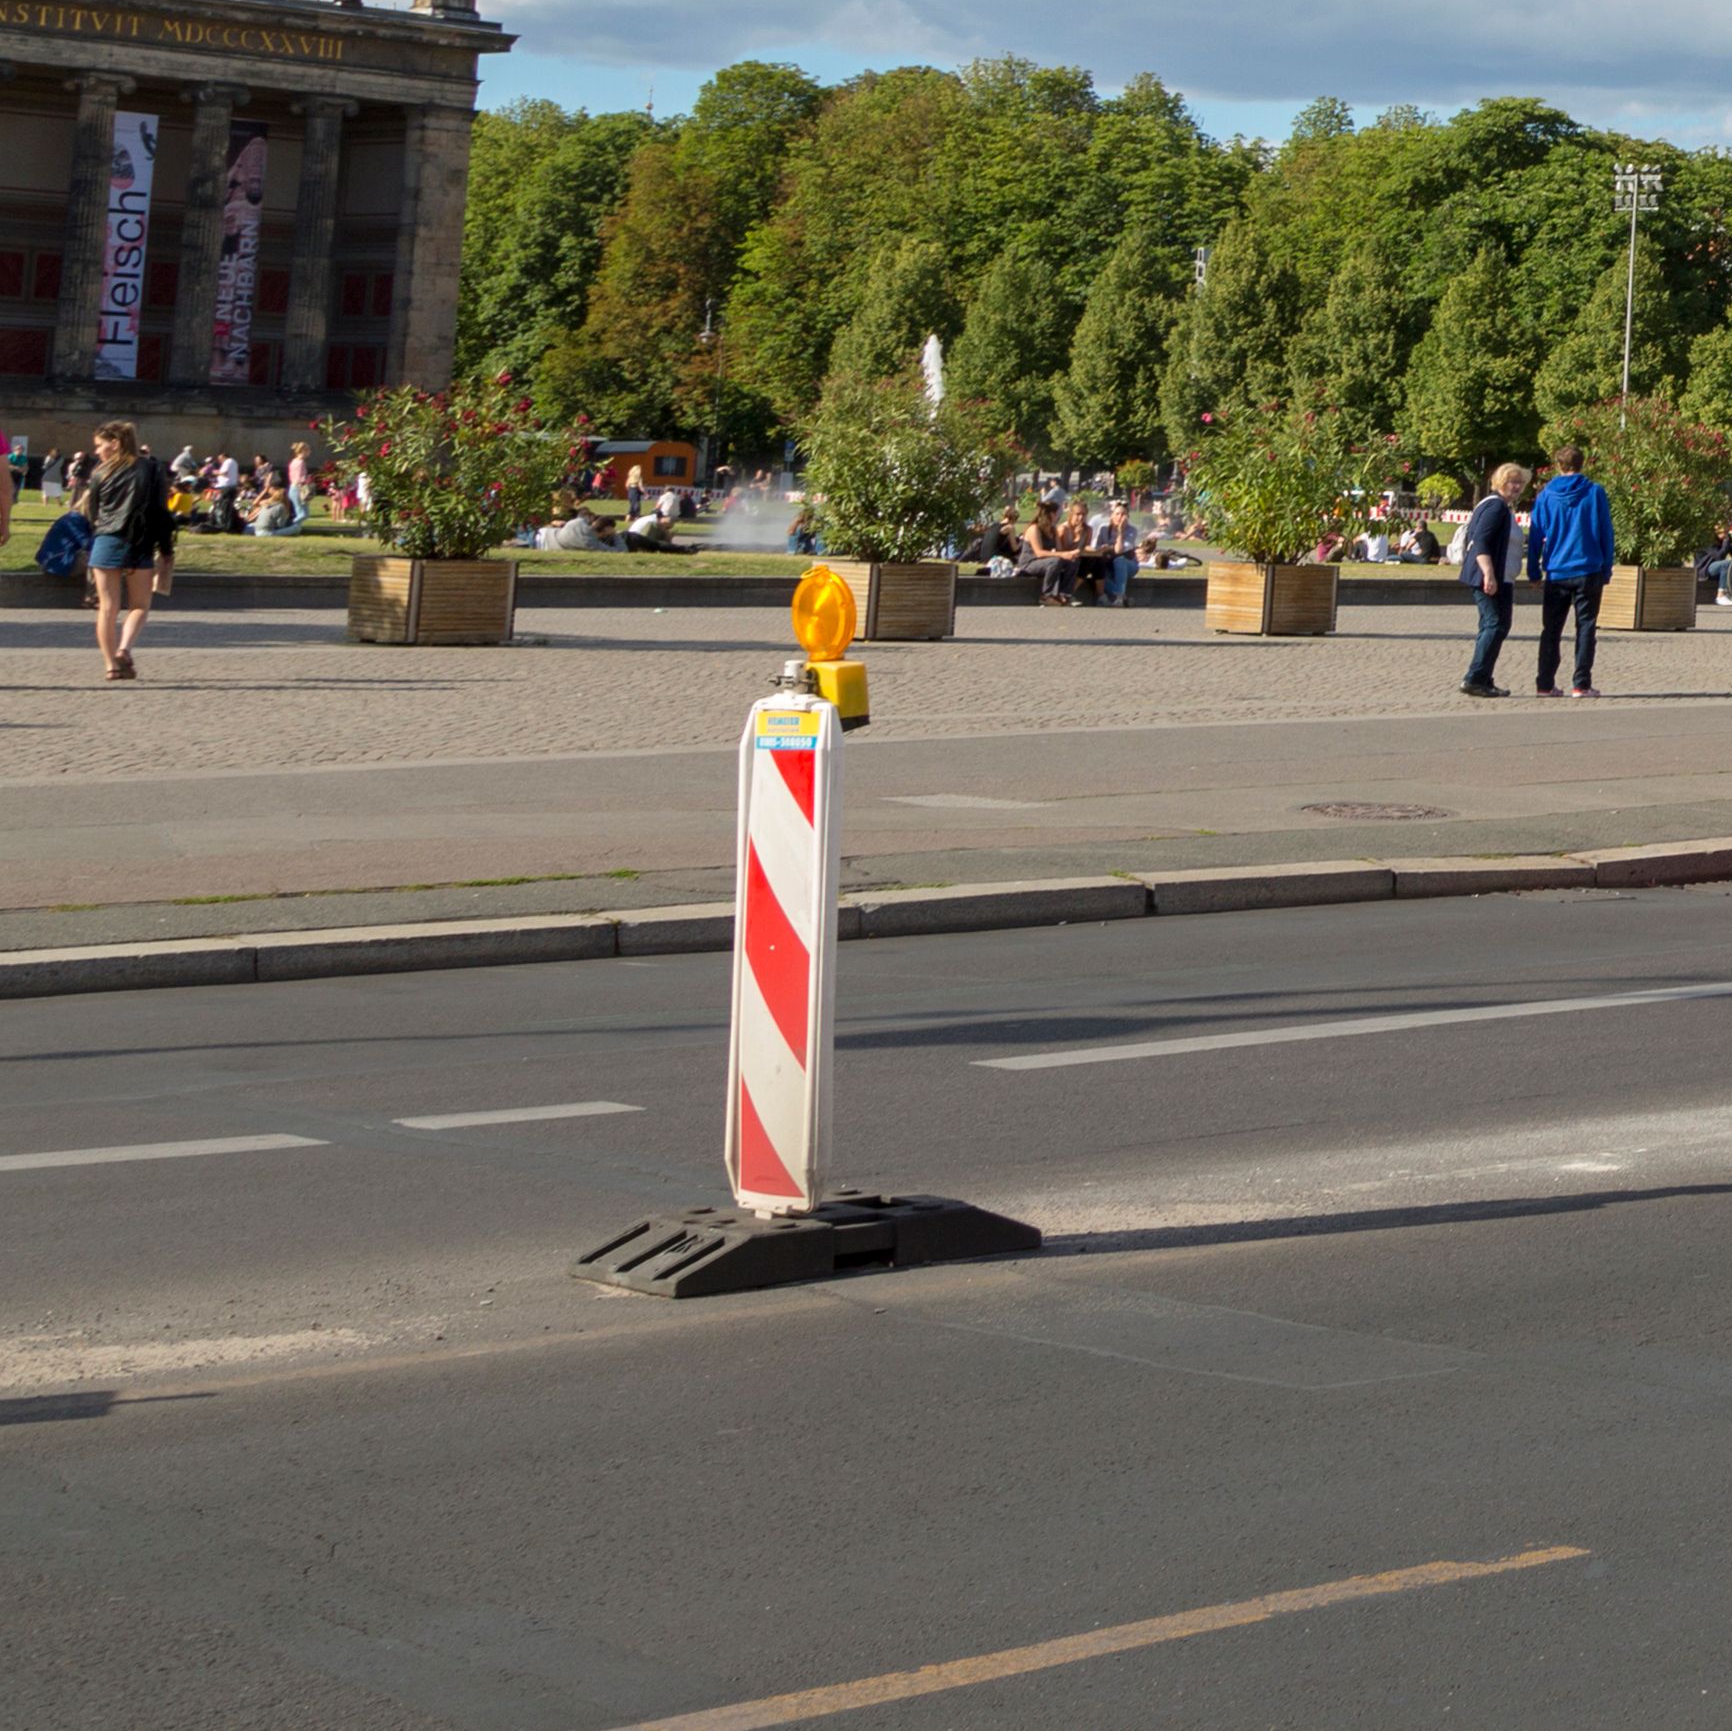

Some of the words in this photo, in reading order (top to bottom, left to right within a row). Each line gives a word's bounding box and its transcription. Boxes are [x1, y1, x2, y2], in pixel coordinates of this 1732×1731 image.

[158, 19, 344, 60] MDCCCXXVIII
[97, 189, 147, 346] Fleisch
[216, 253, 237, 322] NEUE
[230, 220, 260, 360] NACHBARN
